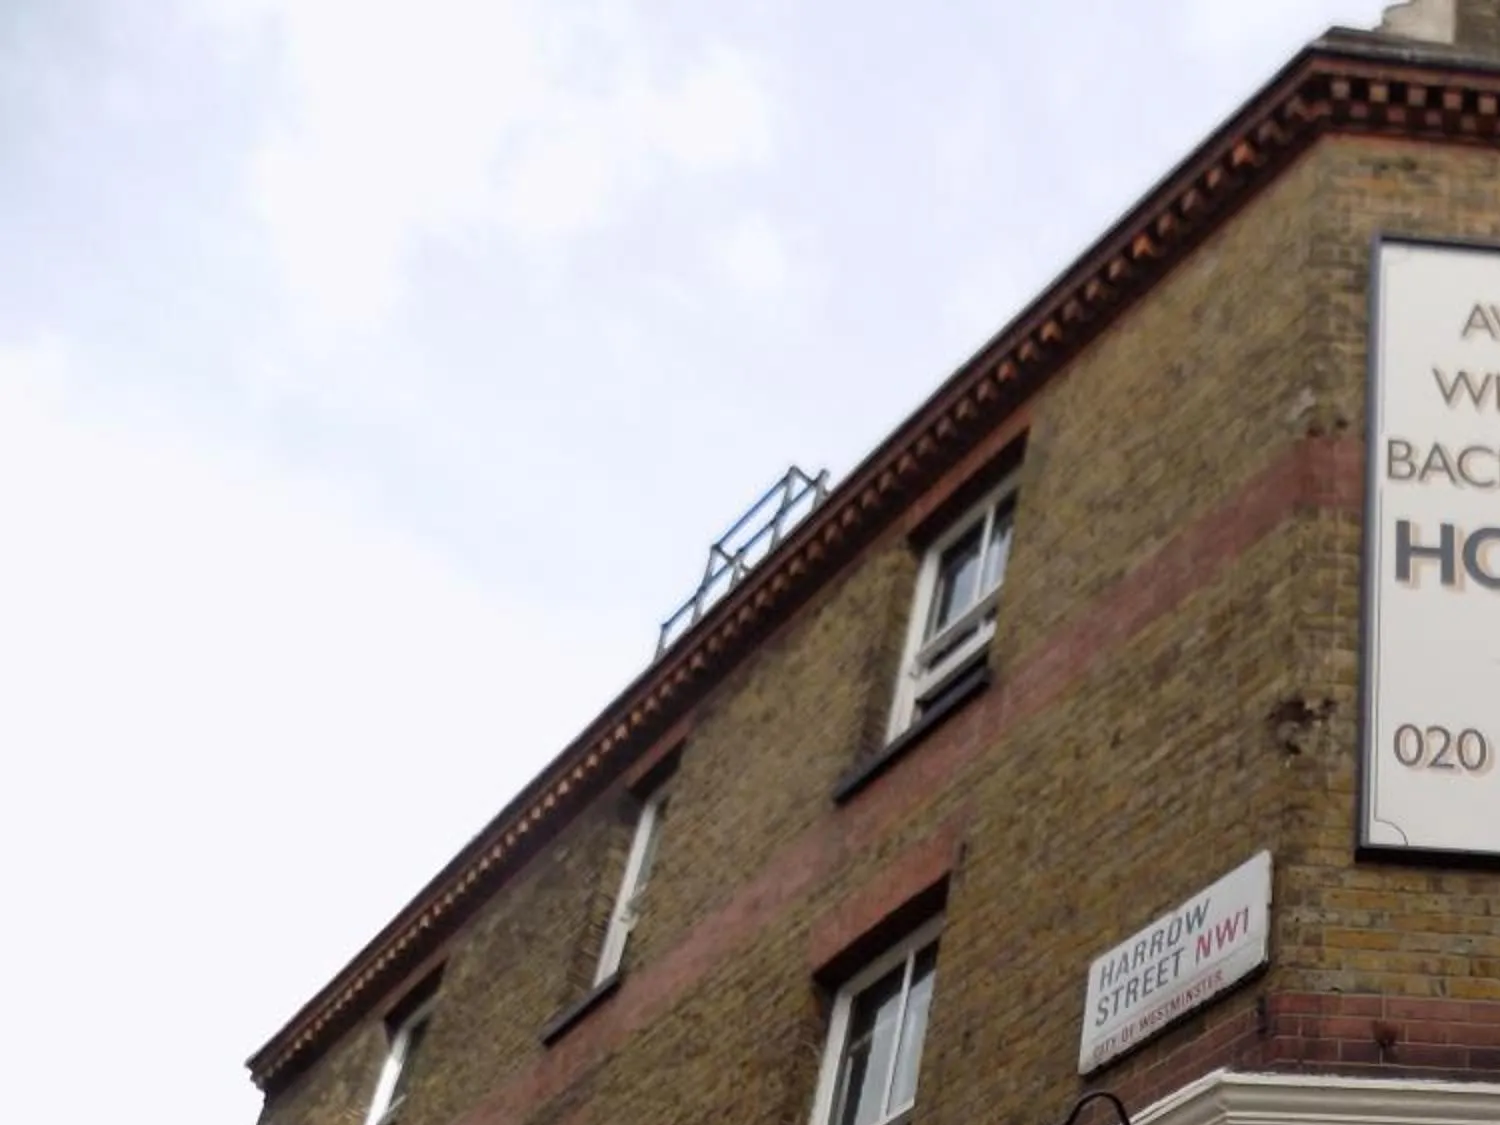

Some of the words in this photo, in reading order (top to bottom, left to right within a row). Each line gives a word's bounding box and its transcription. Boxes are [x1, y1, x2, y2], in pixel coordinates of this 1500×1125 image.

[1393, 723, 1488, 771] 020
[1095, 948, 1184, 1027] STREET
[1195, 906, 1249, 965] NW1
[1100, 898, 1211, 991] HARROW
